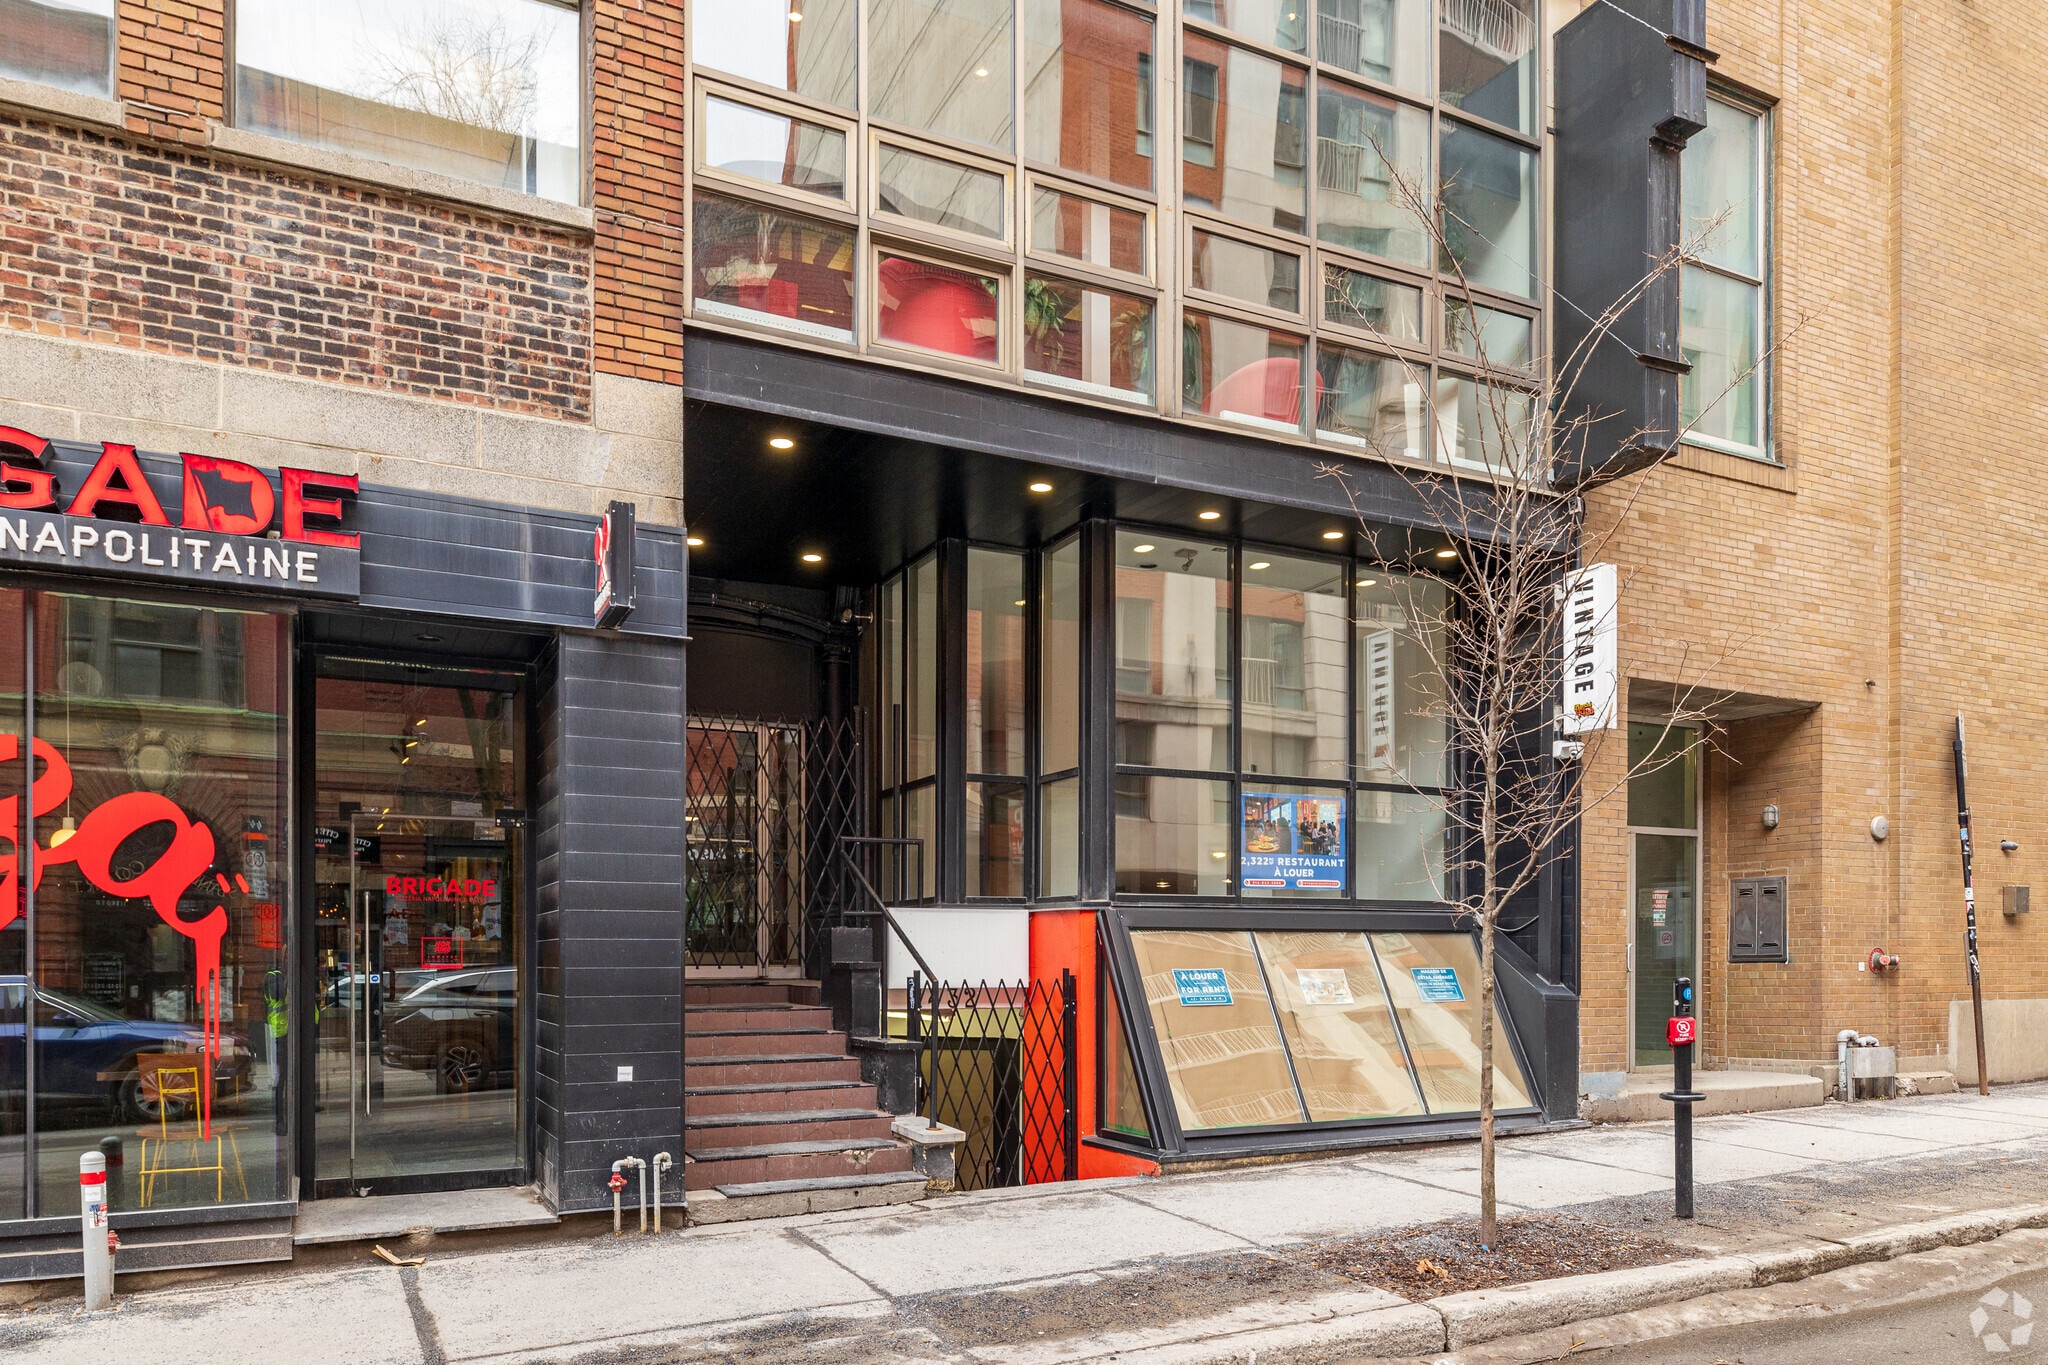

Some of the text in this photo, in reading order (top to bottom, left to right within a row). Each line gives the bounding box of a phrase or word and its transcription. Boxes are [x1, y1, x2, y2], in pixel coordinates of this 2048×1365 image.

[0, 517, 320, 583] NAPOLITAINE
[1574, 577, 1595, 694] VINTAGE
[1277, 857, 1345, 868] RESTAURANT
[1274, 866, 1314, 878] À LOUER
[386, 877, 496, 897] BRIGADE
[1181, 972, 1219, 981] À LOUER
[1181, 986, 1226, 995] FOR RENT
